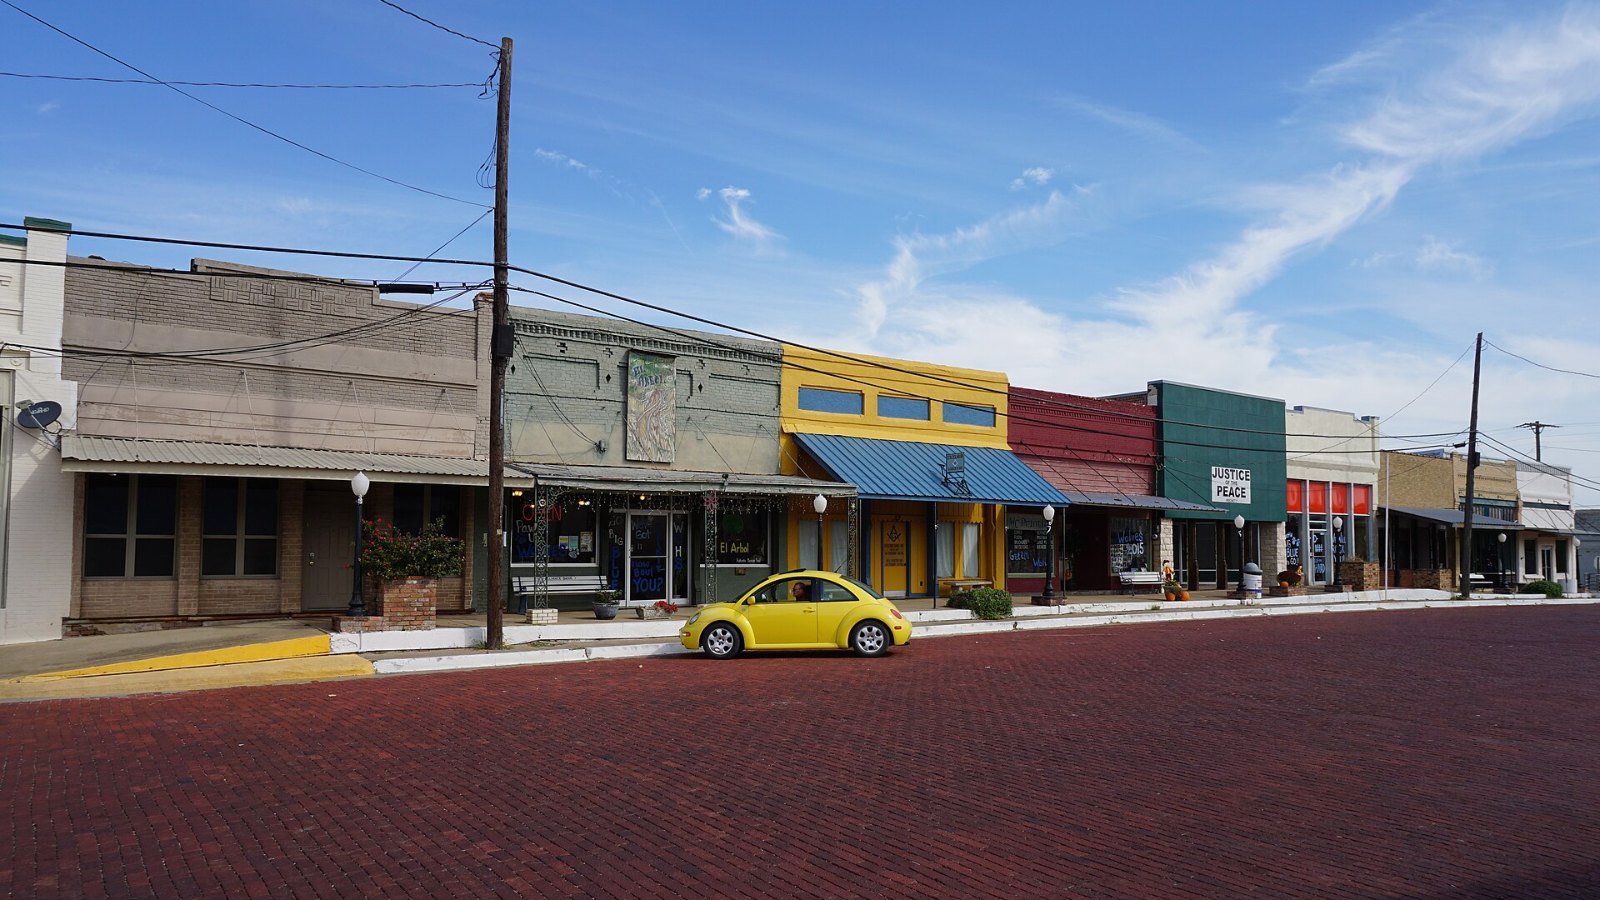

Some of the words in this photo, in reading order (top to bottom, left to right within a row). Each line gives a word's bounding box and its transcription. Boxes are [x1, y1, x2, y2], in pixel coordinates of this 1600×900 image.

[1212, 467, 1250, 482] JUSTICE
[1217, 485, 1246, 499] PEACE
[721, 542, 728, 553] El
[731, 542, 749, 554] Arbol
[633, 577, 663, 592] YOU?
